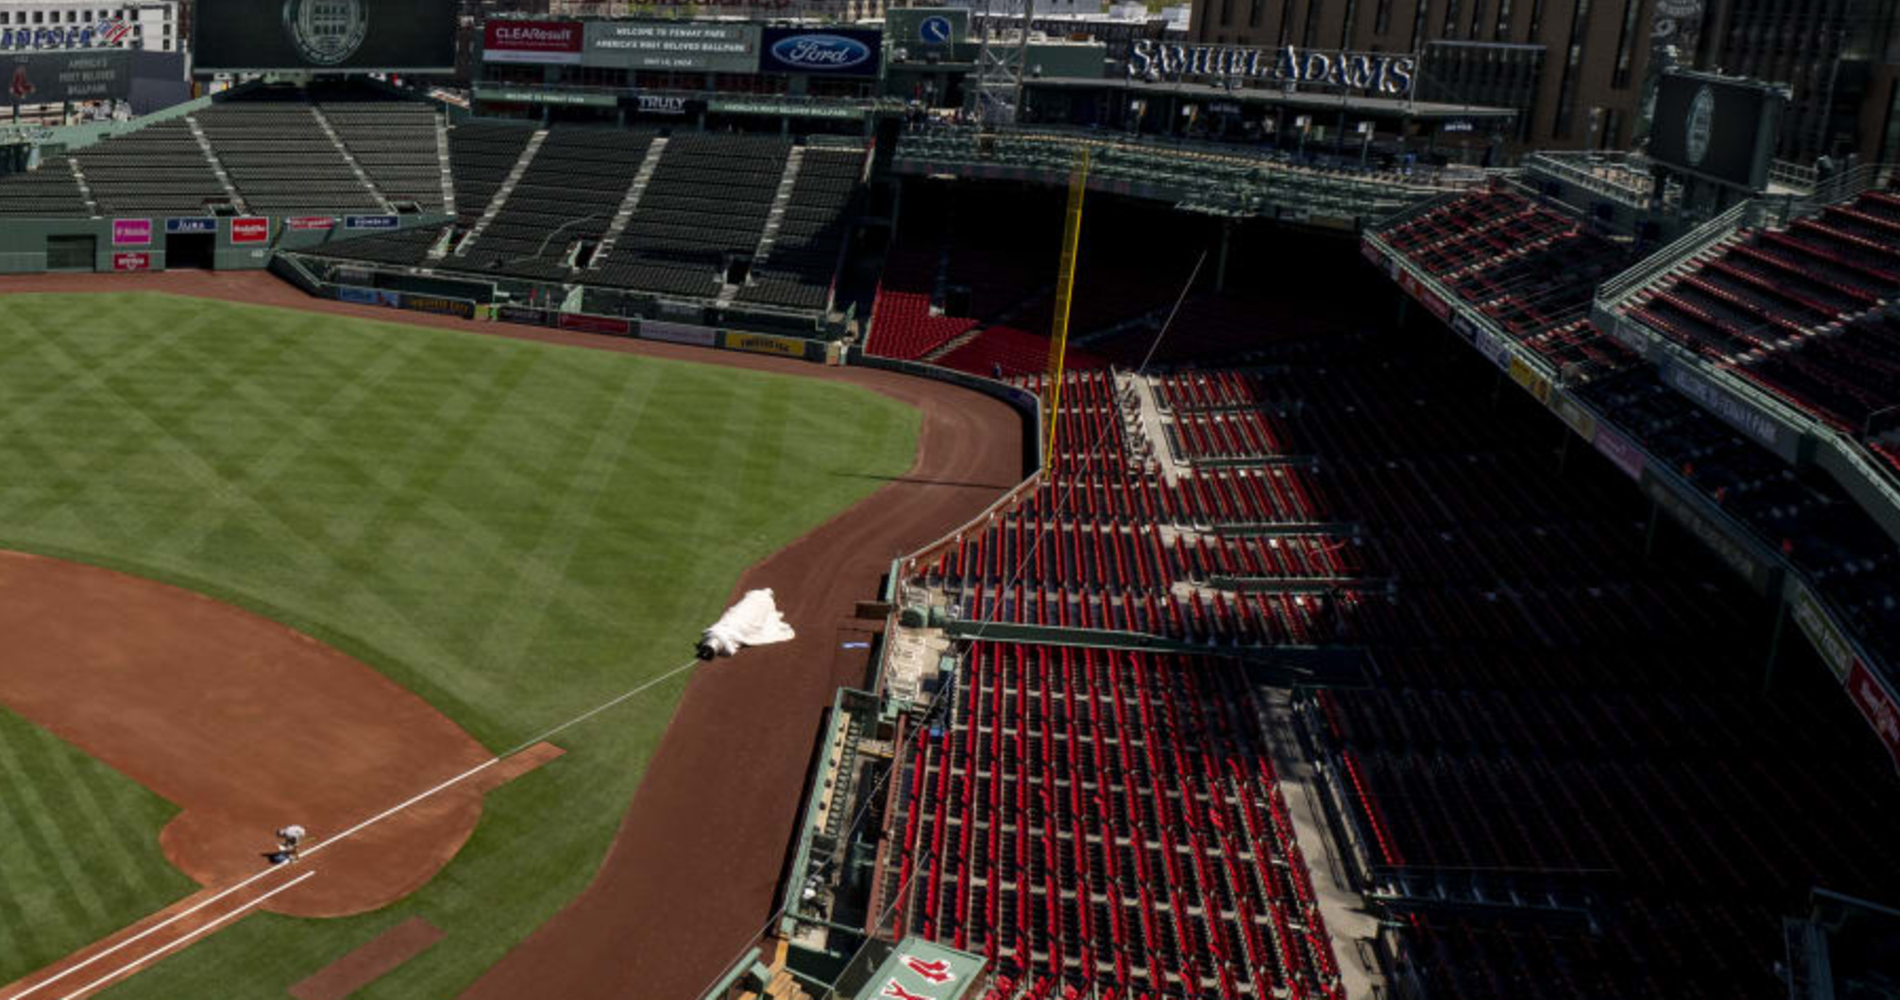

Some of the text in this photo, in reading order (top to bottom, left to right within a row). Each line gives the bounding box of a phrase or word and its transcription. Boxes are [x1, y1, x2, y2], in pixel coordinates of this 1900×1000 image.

[0, 26, 91, 48] AMERICA
[616, 27, 654, 37] WELCOME
[790, 40, 849, 62] Ford
[1128, 39, 1414, 93] SAMUEL ADAMS
[638, 95, 685, 109] TRULY
